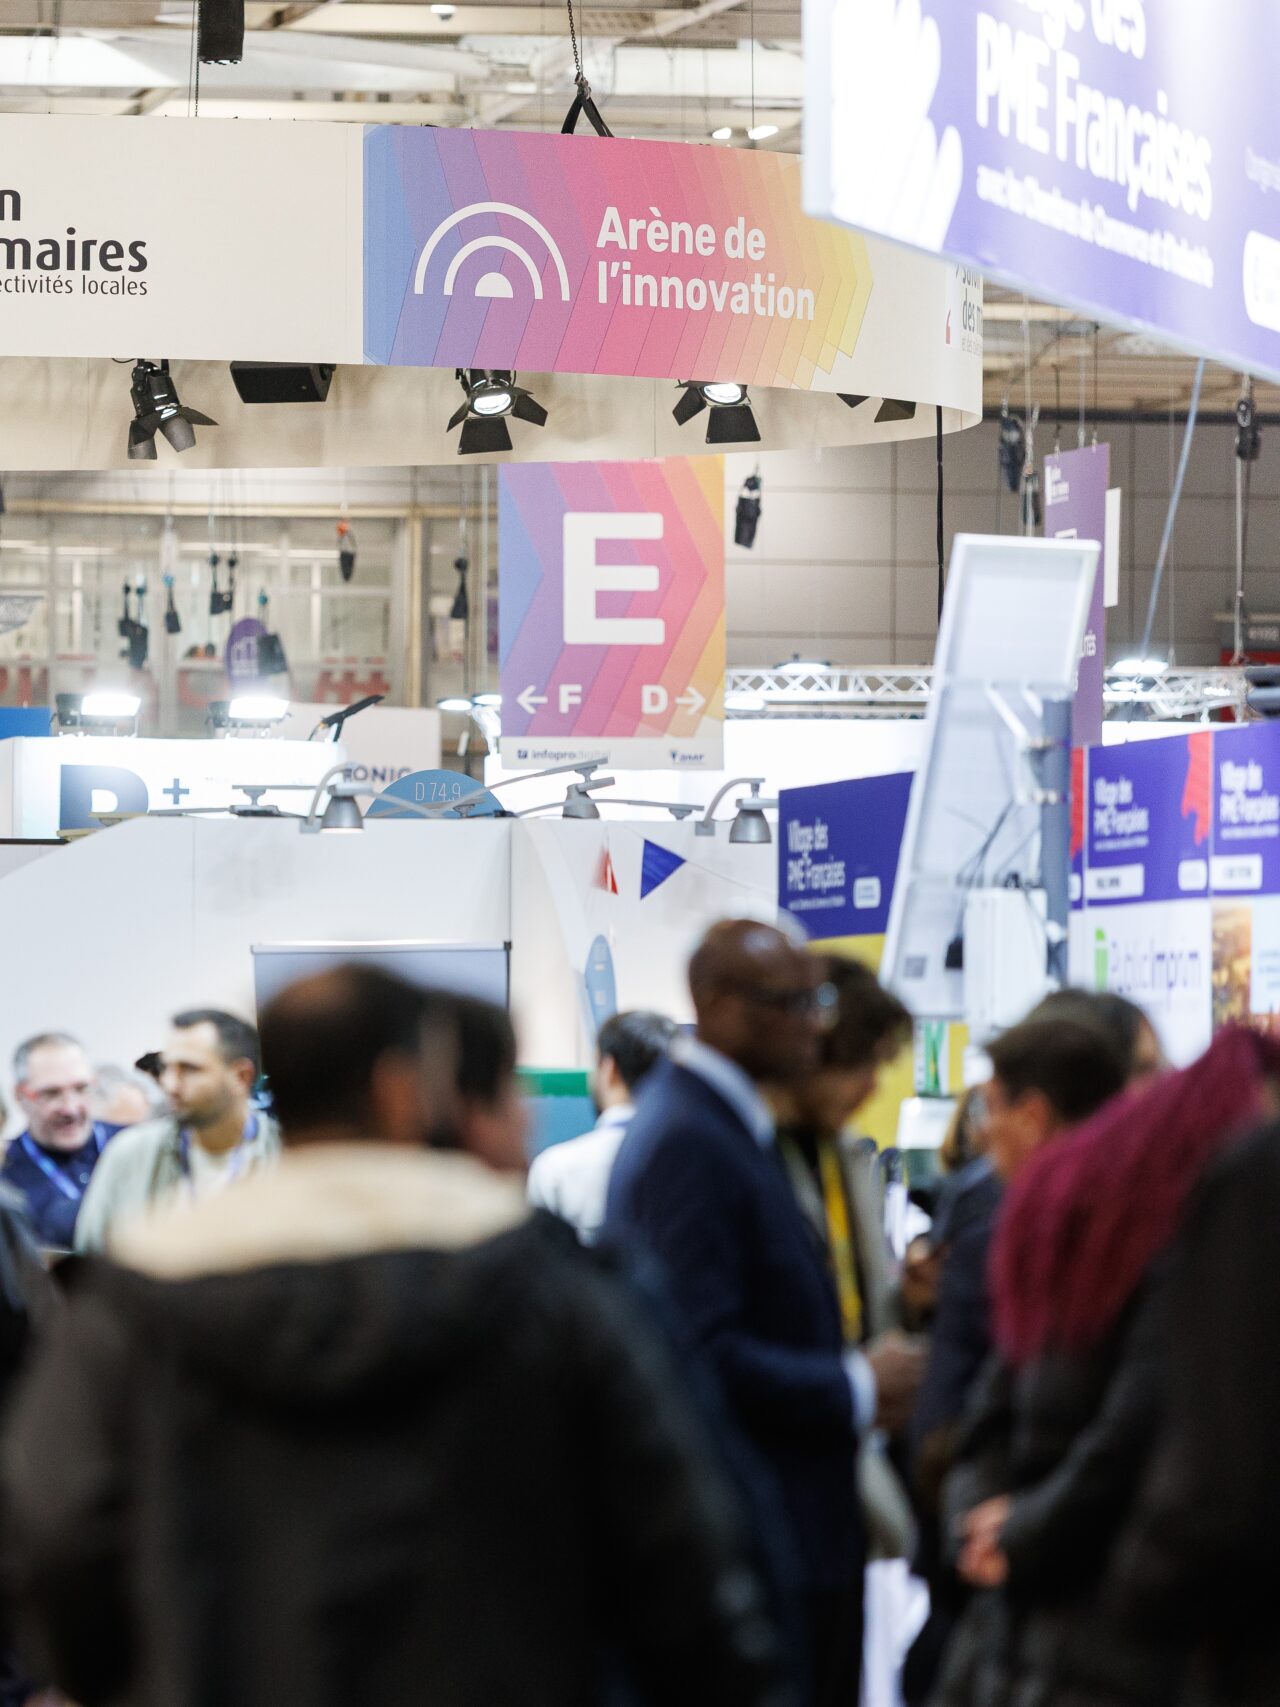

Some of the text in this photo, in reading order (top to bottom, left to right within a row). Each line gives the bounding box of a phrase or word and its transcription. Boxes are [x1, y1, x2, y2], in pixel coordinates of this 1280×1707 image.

[976, 12, 1050, 154] PME
[1056, 48, 1212, 221] Françaises
[596, 206, 766, 261] Arène de
[82, 274, 148, 296] locales
[597, 260, 815, 321] l'innovation
[563, 512, 665, 645] E
[559, 684, 668, 714] F D
[415, 782, 461, 801] D 74.9
